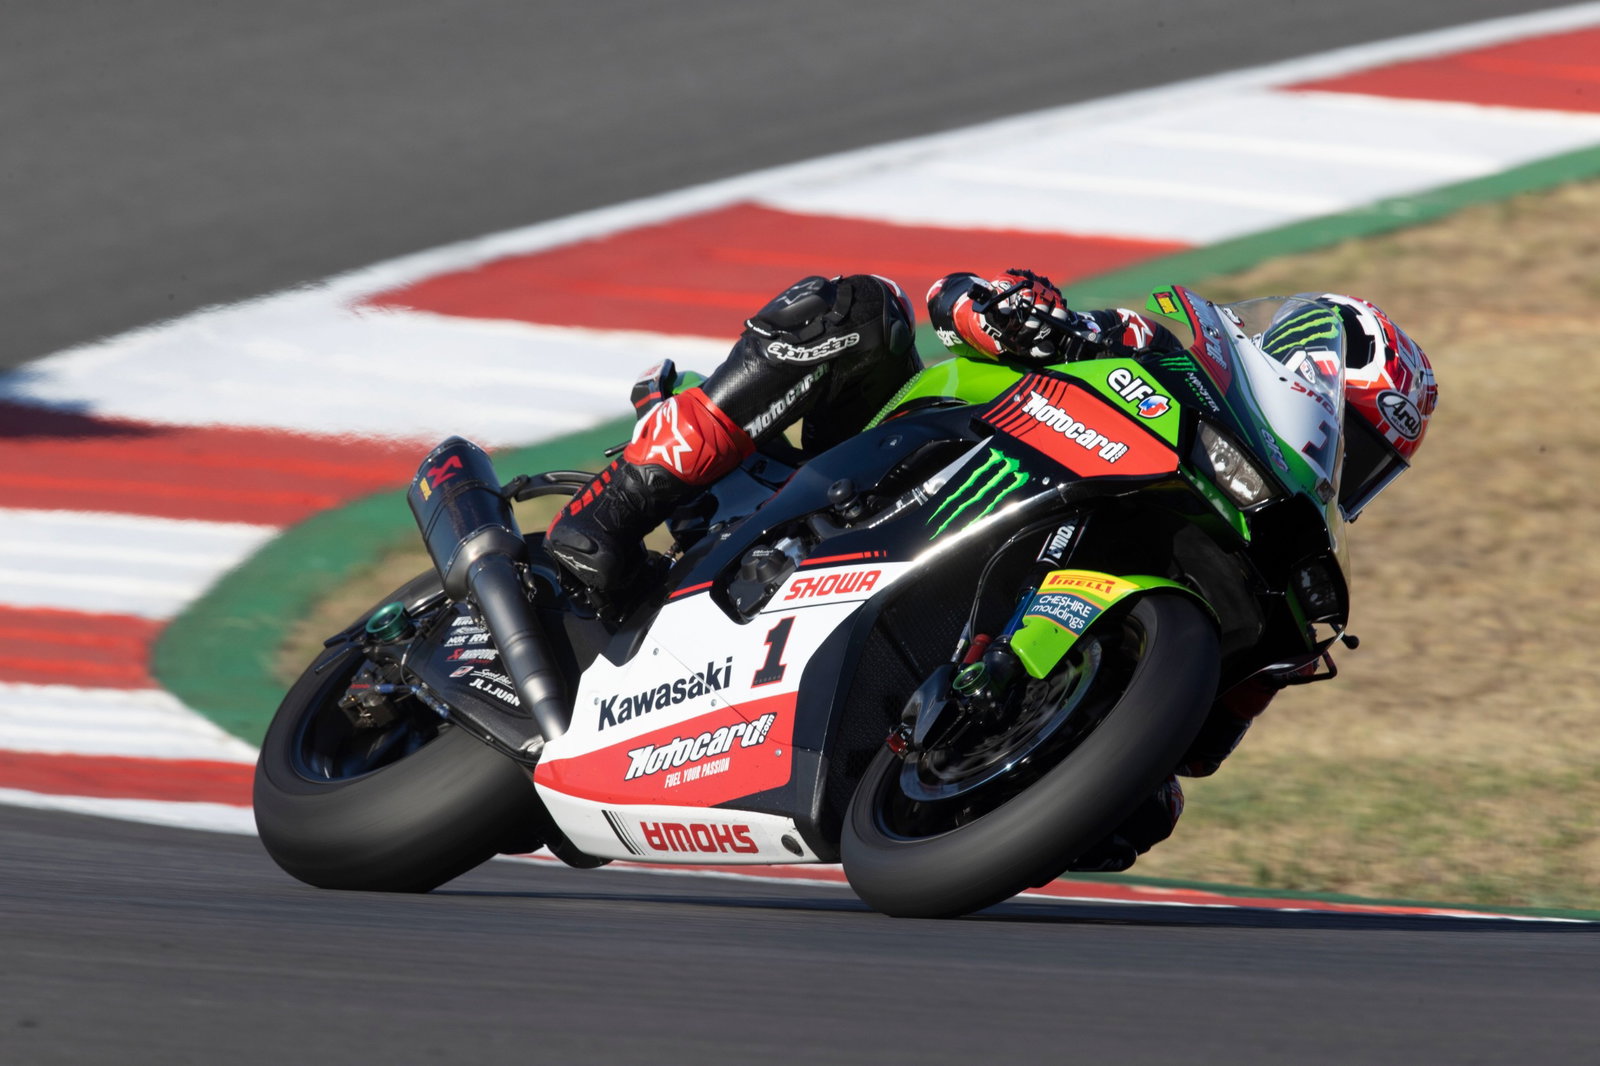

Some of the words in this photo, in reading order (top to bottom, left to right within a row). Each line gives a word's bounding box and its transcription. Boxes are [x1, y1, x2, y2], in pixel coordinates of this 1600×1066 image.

[1108, 368, 1152, 402] elf
[784, 570, 881, 600] SHOWA
[1048, 574, 1116, 594] PIRELLI
[1031, 604, 1085, 629] mouldings
[1039, 595, 1092, 618] CHESHIRE
[751, 616, 796, 688] 1
[598, 656, 733, 731] Kawasaki
[664, 771, 681, 788] FUEL
[682, 765, 700, 782] YOUR
[701, 757, 730, 777] PASSION
